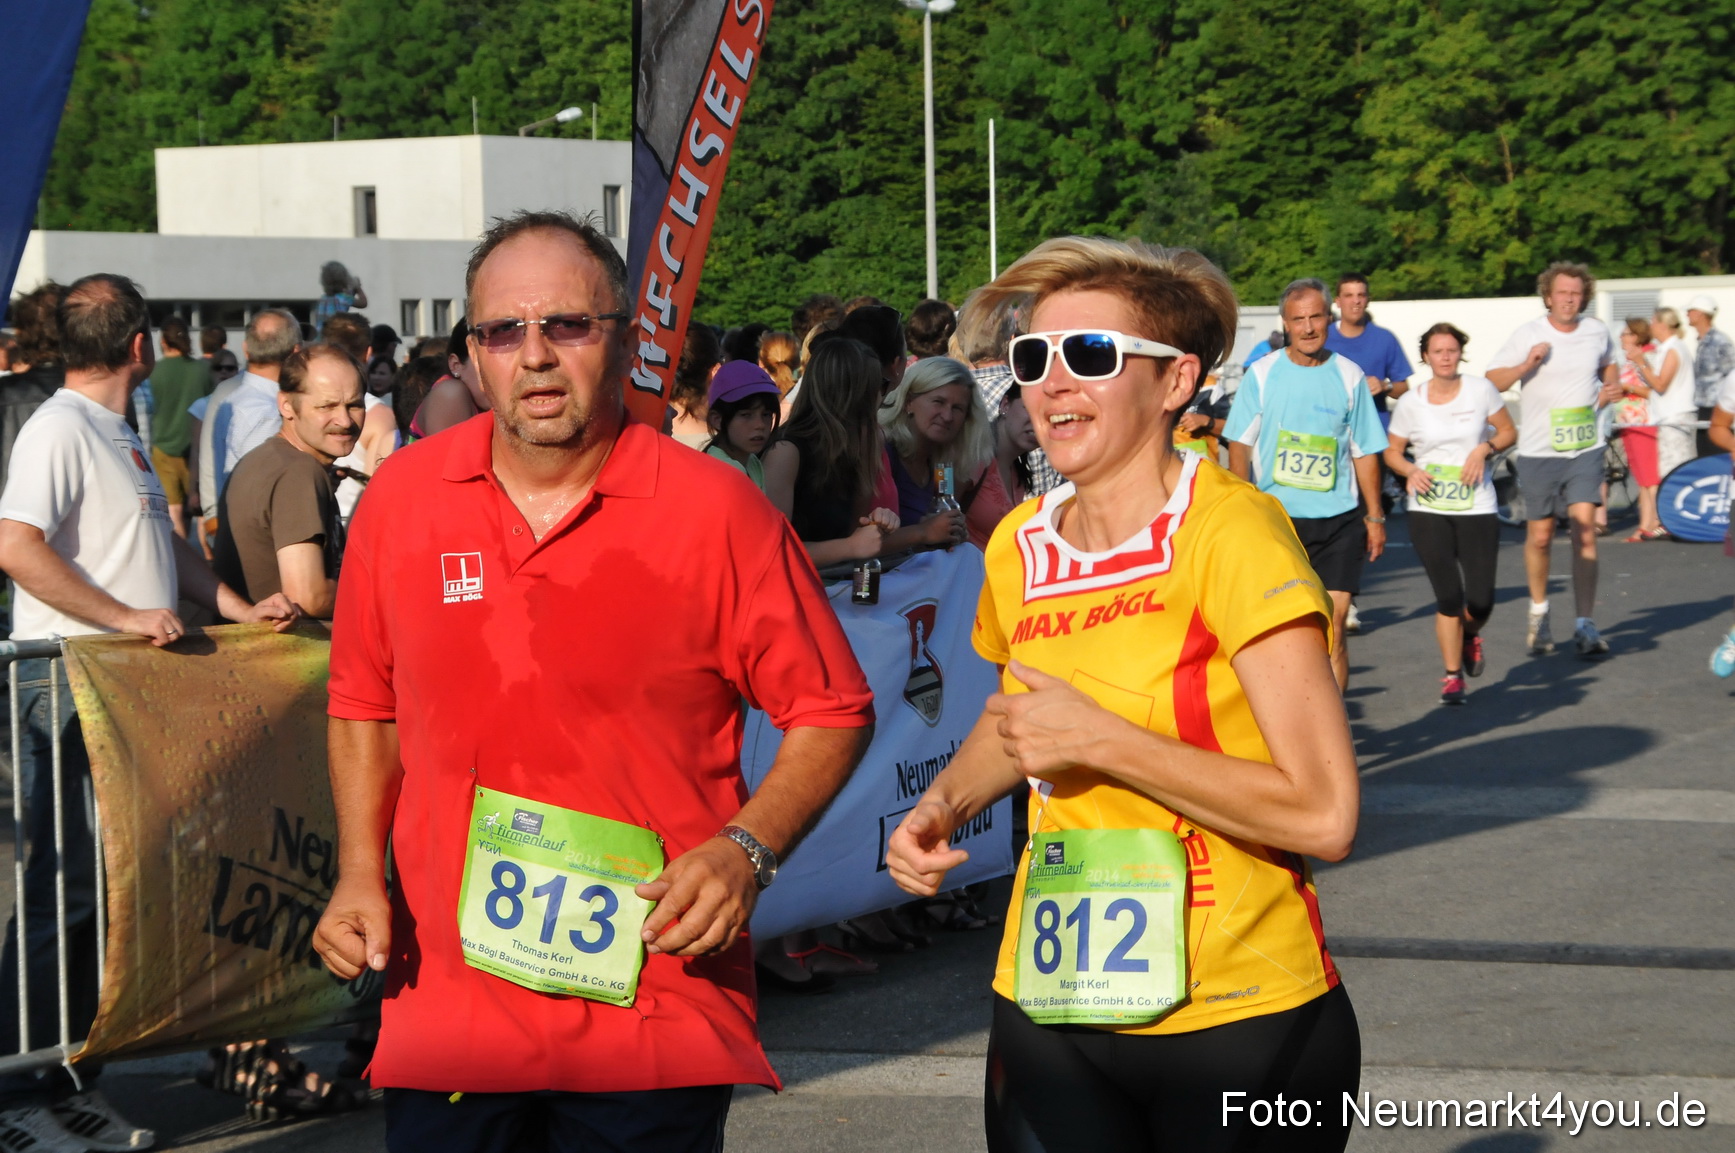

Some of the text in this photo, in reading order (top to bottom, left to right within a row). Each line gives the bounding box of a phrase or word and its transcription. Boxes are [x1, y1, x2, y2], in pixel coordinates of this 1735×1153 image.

[1555, 424, 1595, 443] 5103
[1278, 450, 1333, 477] 1373
[1431, 481, 1471, 501] 020
[443, 592, 483, 604] MAX BÖGL
[1010, 610, 1077, 645] MAX
[1082, 588, 1166, 630] BÖGL
[495, 823, 567, 852] firmenlauf
[564, 850, 602, 868] 2014
[1036, 860, 1085, 877] firmenlauf
[1085, 869, 1120, 882] 2014
[485, 860, 619, 954] 813
[1033, 897, 1149, 974] 812
[512, 938, 574, 965] Thomas Kerl
[461, 936, 477, 951] Max
[478, 943, 498, 958] Bögl
[499, 951, 546, 975] Bauservice
[548, 967, 579, 982] GmbH
[581, 975, 589, 984] &
[591, 976, 607, 988] Co.
[610, 980, 626, 991] KG
[1060, 979, 1109, 991] Margit Kerl
[1020, 996, 1173, 1008] Max Bögl Bauservice GmbH & Co. KG
